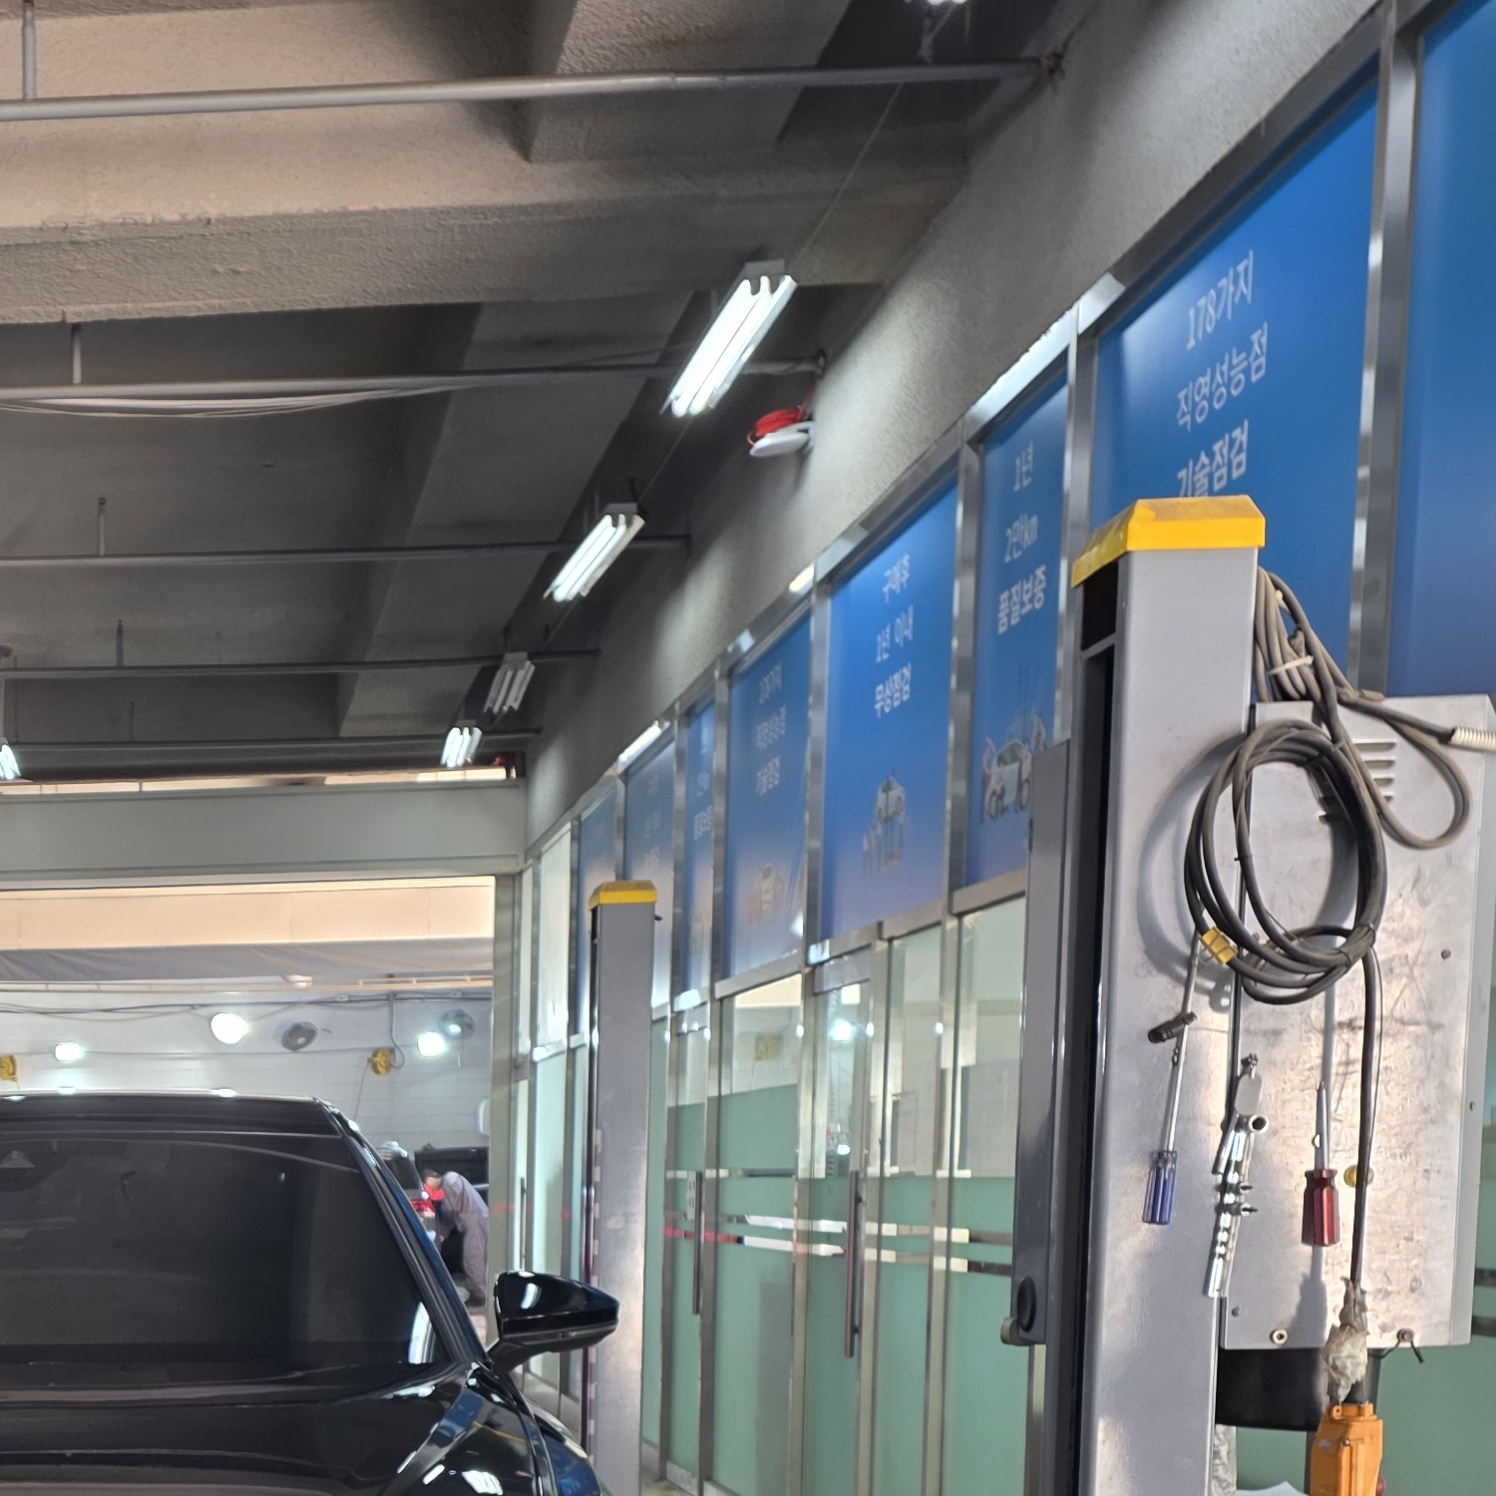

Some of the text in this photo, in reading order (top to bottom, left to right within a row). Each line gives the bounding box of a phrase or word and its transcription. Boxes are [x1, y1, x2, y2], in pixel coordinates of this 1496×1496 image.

[1186, 249, 1254, 350] 178가지
[1176, 321, 1268, 432] 직영성능점
[1014, 441, 1034, 492] 1년
[1176, 418, 1249, 497] 기술점검
[997, 564, 1047, 635] 품질보증
[874, 661, 912, 719] 무상점검
